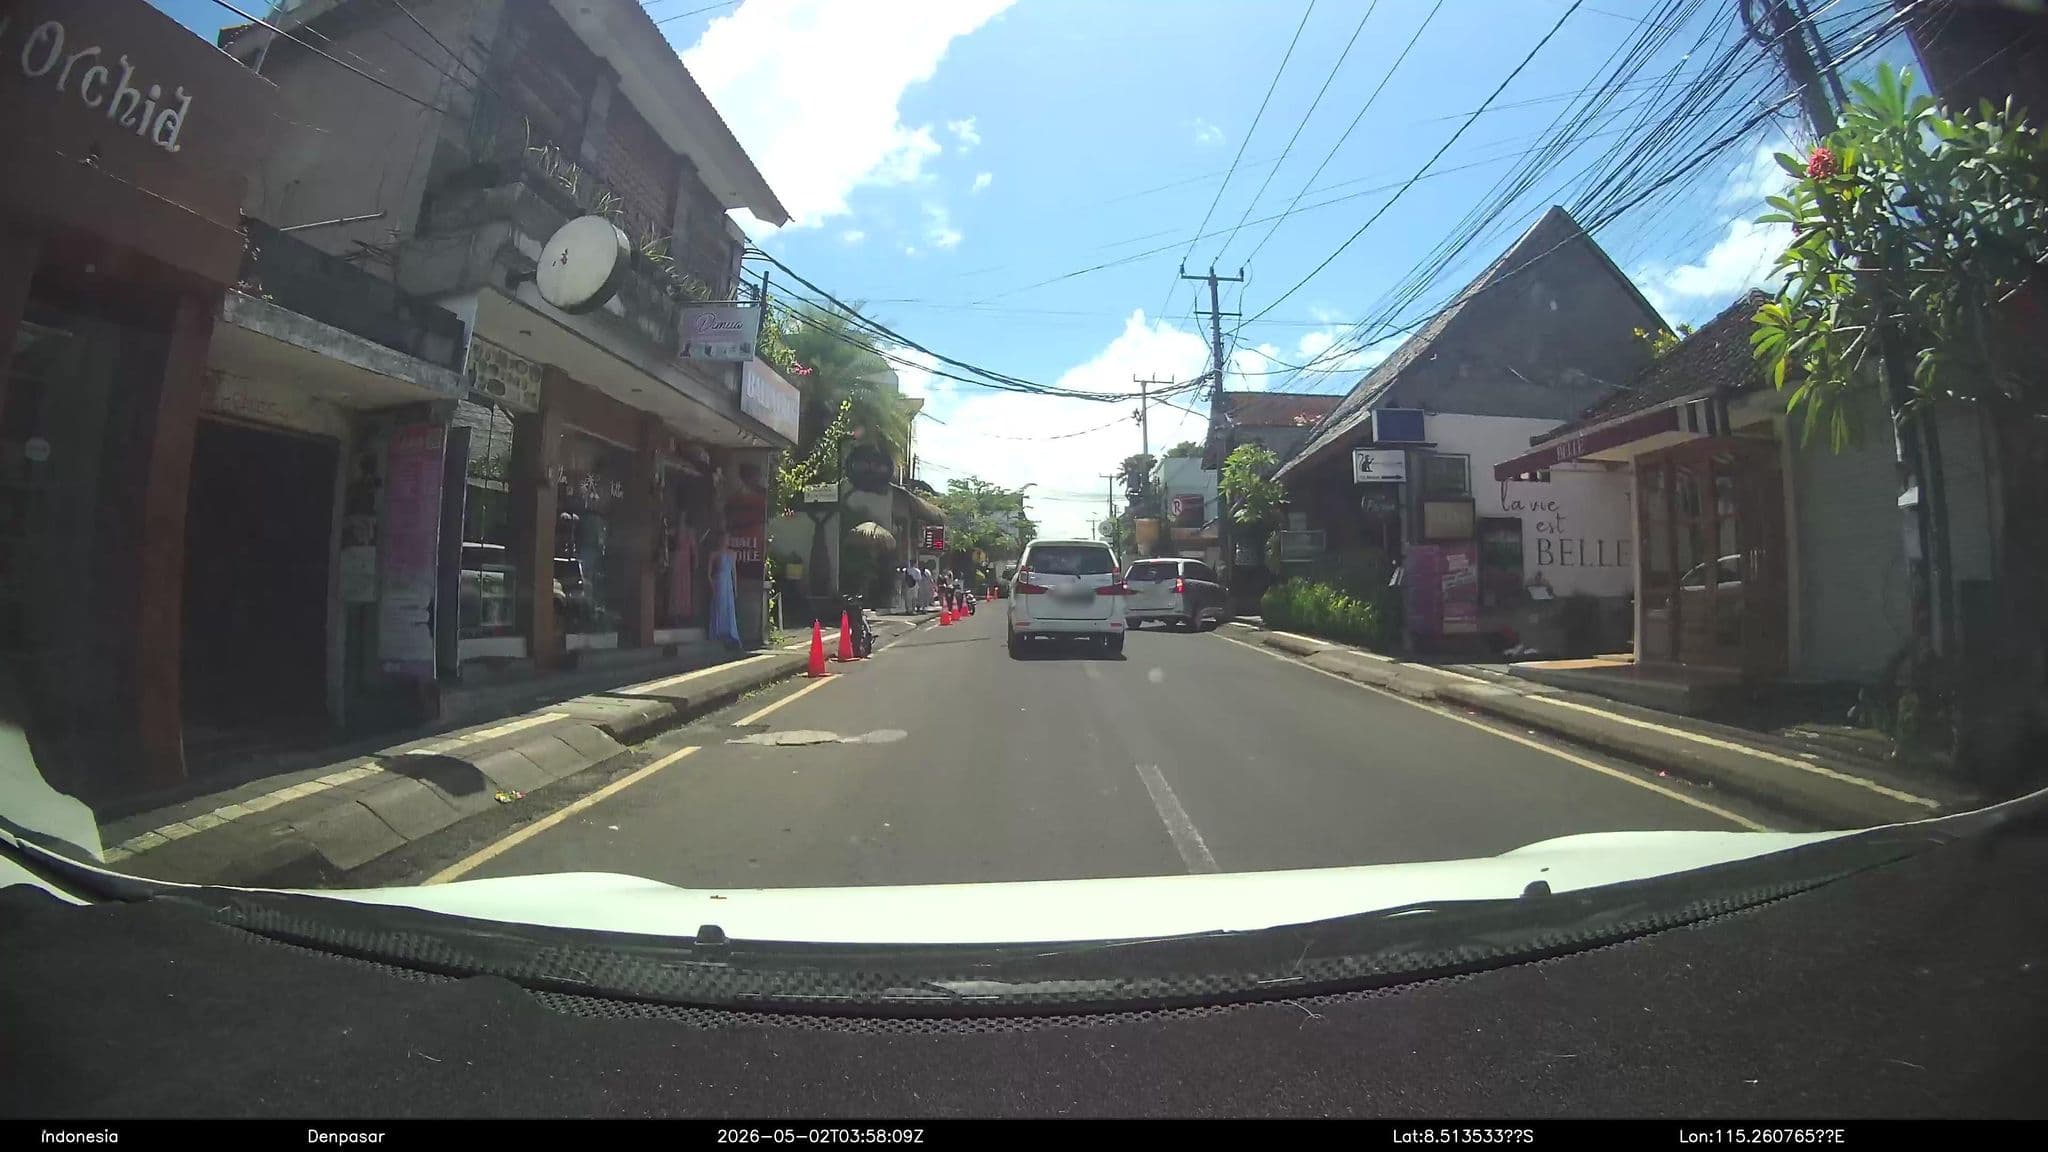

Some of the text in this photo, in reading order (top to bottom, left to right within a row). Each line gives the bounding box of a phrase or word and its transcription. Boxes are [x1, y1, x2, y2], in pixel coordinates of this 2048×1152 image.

[21, 20, 193, 153] Orchid
[1556, 438, 1586, 461] BELLE
[1530, 497, 1560, 512] vie
[1536, 512, 1567, 535] est
[1536, 537, 1632, 567] BELLE
